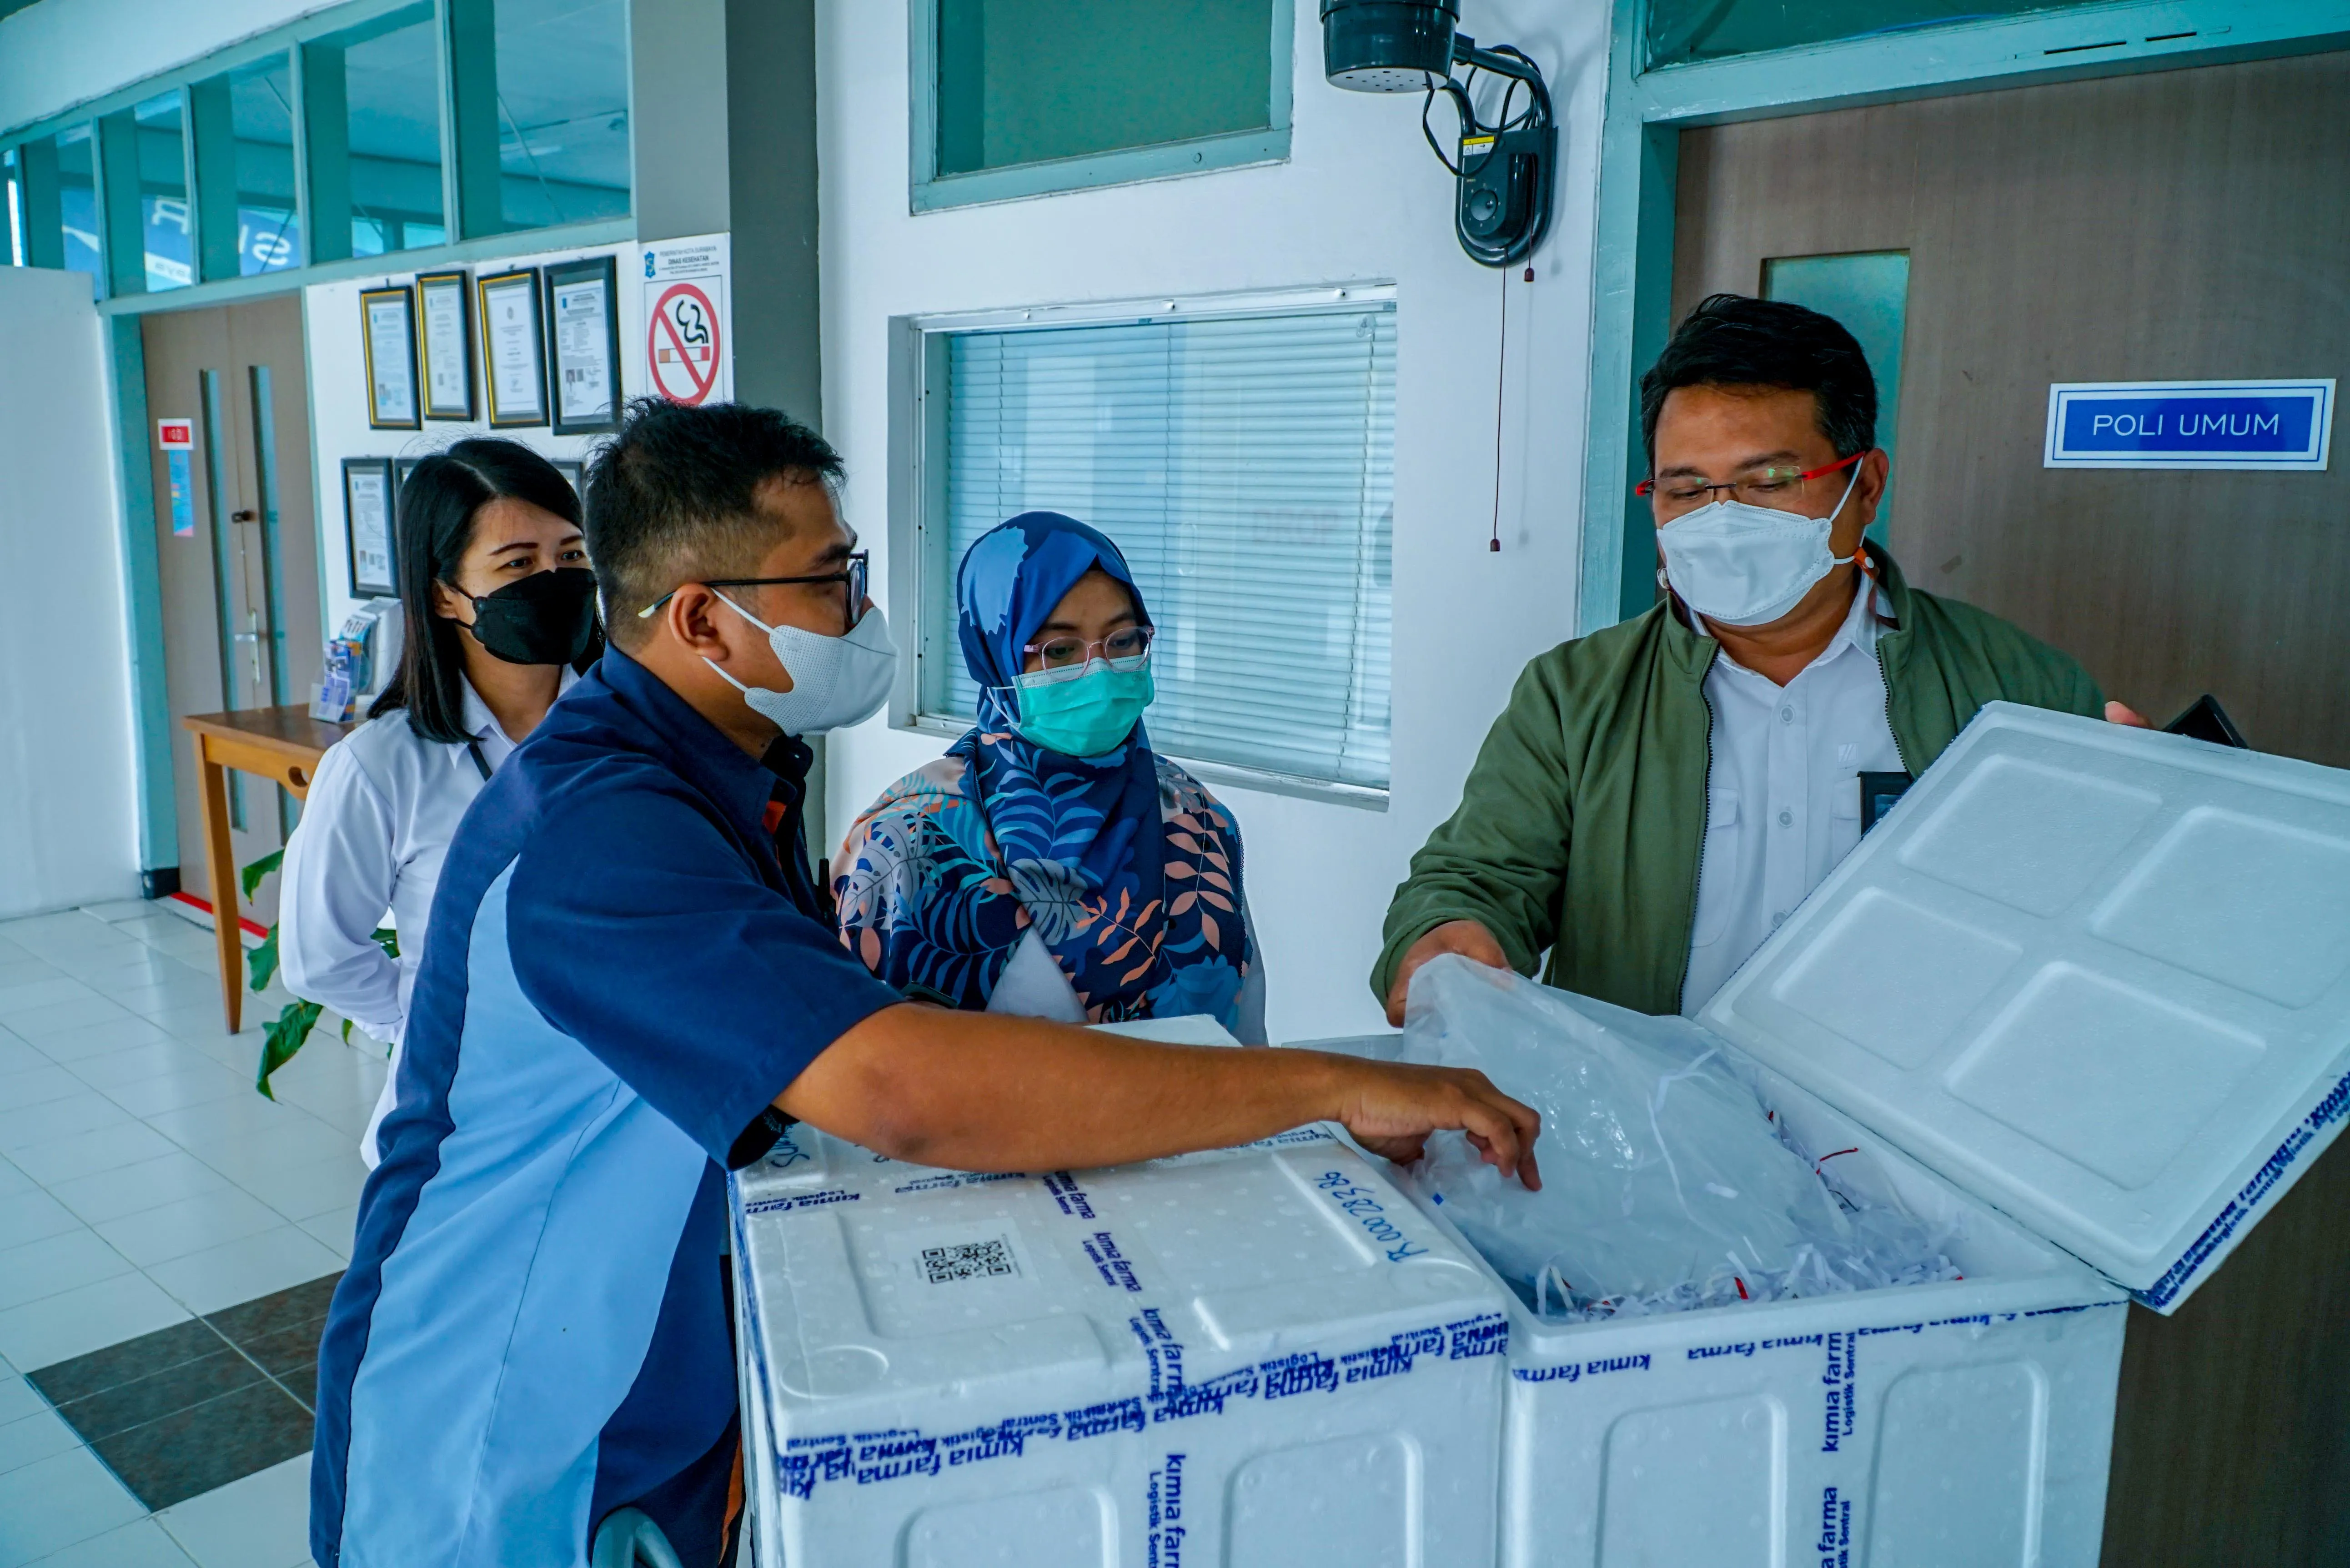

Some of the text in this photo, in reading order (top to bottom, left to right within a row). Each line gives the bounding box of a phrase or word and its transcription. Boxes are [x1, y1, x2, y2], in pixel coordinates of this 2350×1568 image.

[682, 255, 709, 263] KESEHATAN
[2093, 414, 2279, 436] POLI UMUM
[799, 1194, 860, 1207] kimia
[1069, 1192, 1096, 1219] farma
[1093, 1231, 1143, 1292] kimia farma
[1140, 1307, 1172, 1339] kimia
[1260, 1351, 1320, 1374] Logistik
[1687, 1341, 1756, 1361] farma
[1346, 1355, 1413, 1385] kimia
[1512, 1353, 1652, 1384] kimia farma
[1842, 1332, 1857, 1436] Logistik Sentral
[1822, 1391, 1841, 1452] kimia
[948, 1434, 1024, 1468] kimia
[857, 1452, 942, 1486] farma
[1147, 1471, 1162, 1530] Logistik
[1165, 1454, 1186, 1520] kimia
[1818, 1487, 1838, 1553] farma
[1838, 1501, 1851, 1546] Sentral
